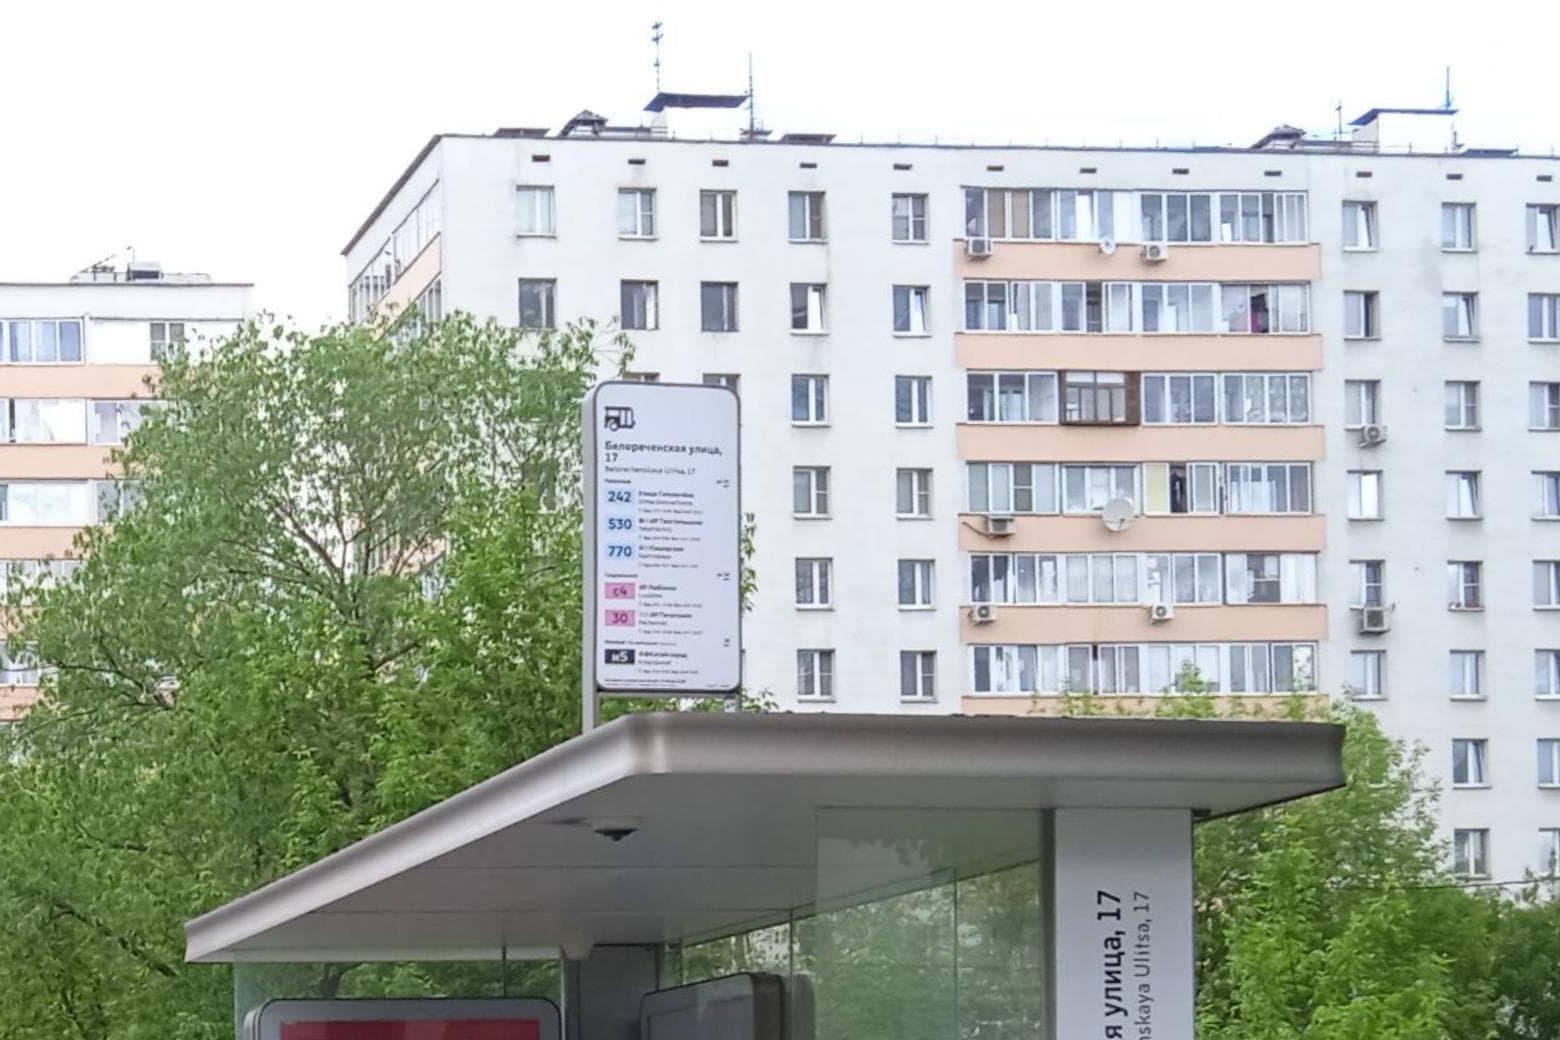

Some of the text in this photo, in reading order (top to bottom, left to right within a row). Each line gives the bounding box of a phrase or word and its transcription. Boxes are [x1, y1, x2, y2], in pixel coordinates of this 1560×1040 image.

[605, 441, 722, 457] Белореченская улица,
[605, 453, 618, 462] 17
[608, 491, 632, 502] 242
[608, 518, 632, 530] 530
[608, 545, 632, 557] 770
[612, 613, 628, 624] 30
[1097, 890, 1122, 921] 17
[1134, 891, 1150, 913] 17
[1134, 918, 1152, 977] Ulitsa,
[1103, 930, 1128, 1017] улица,
